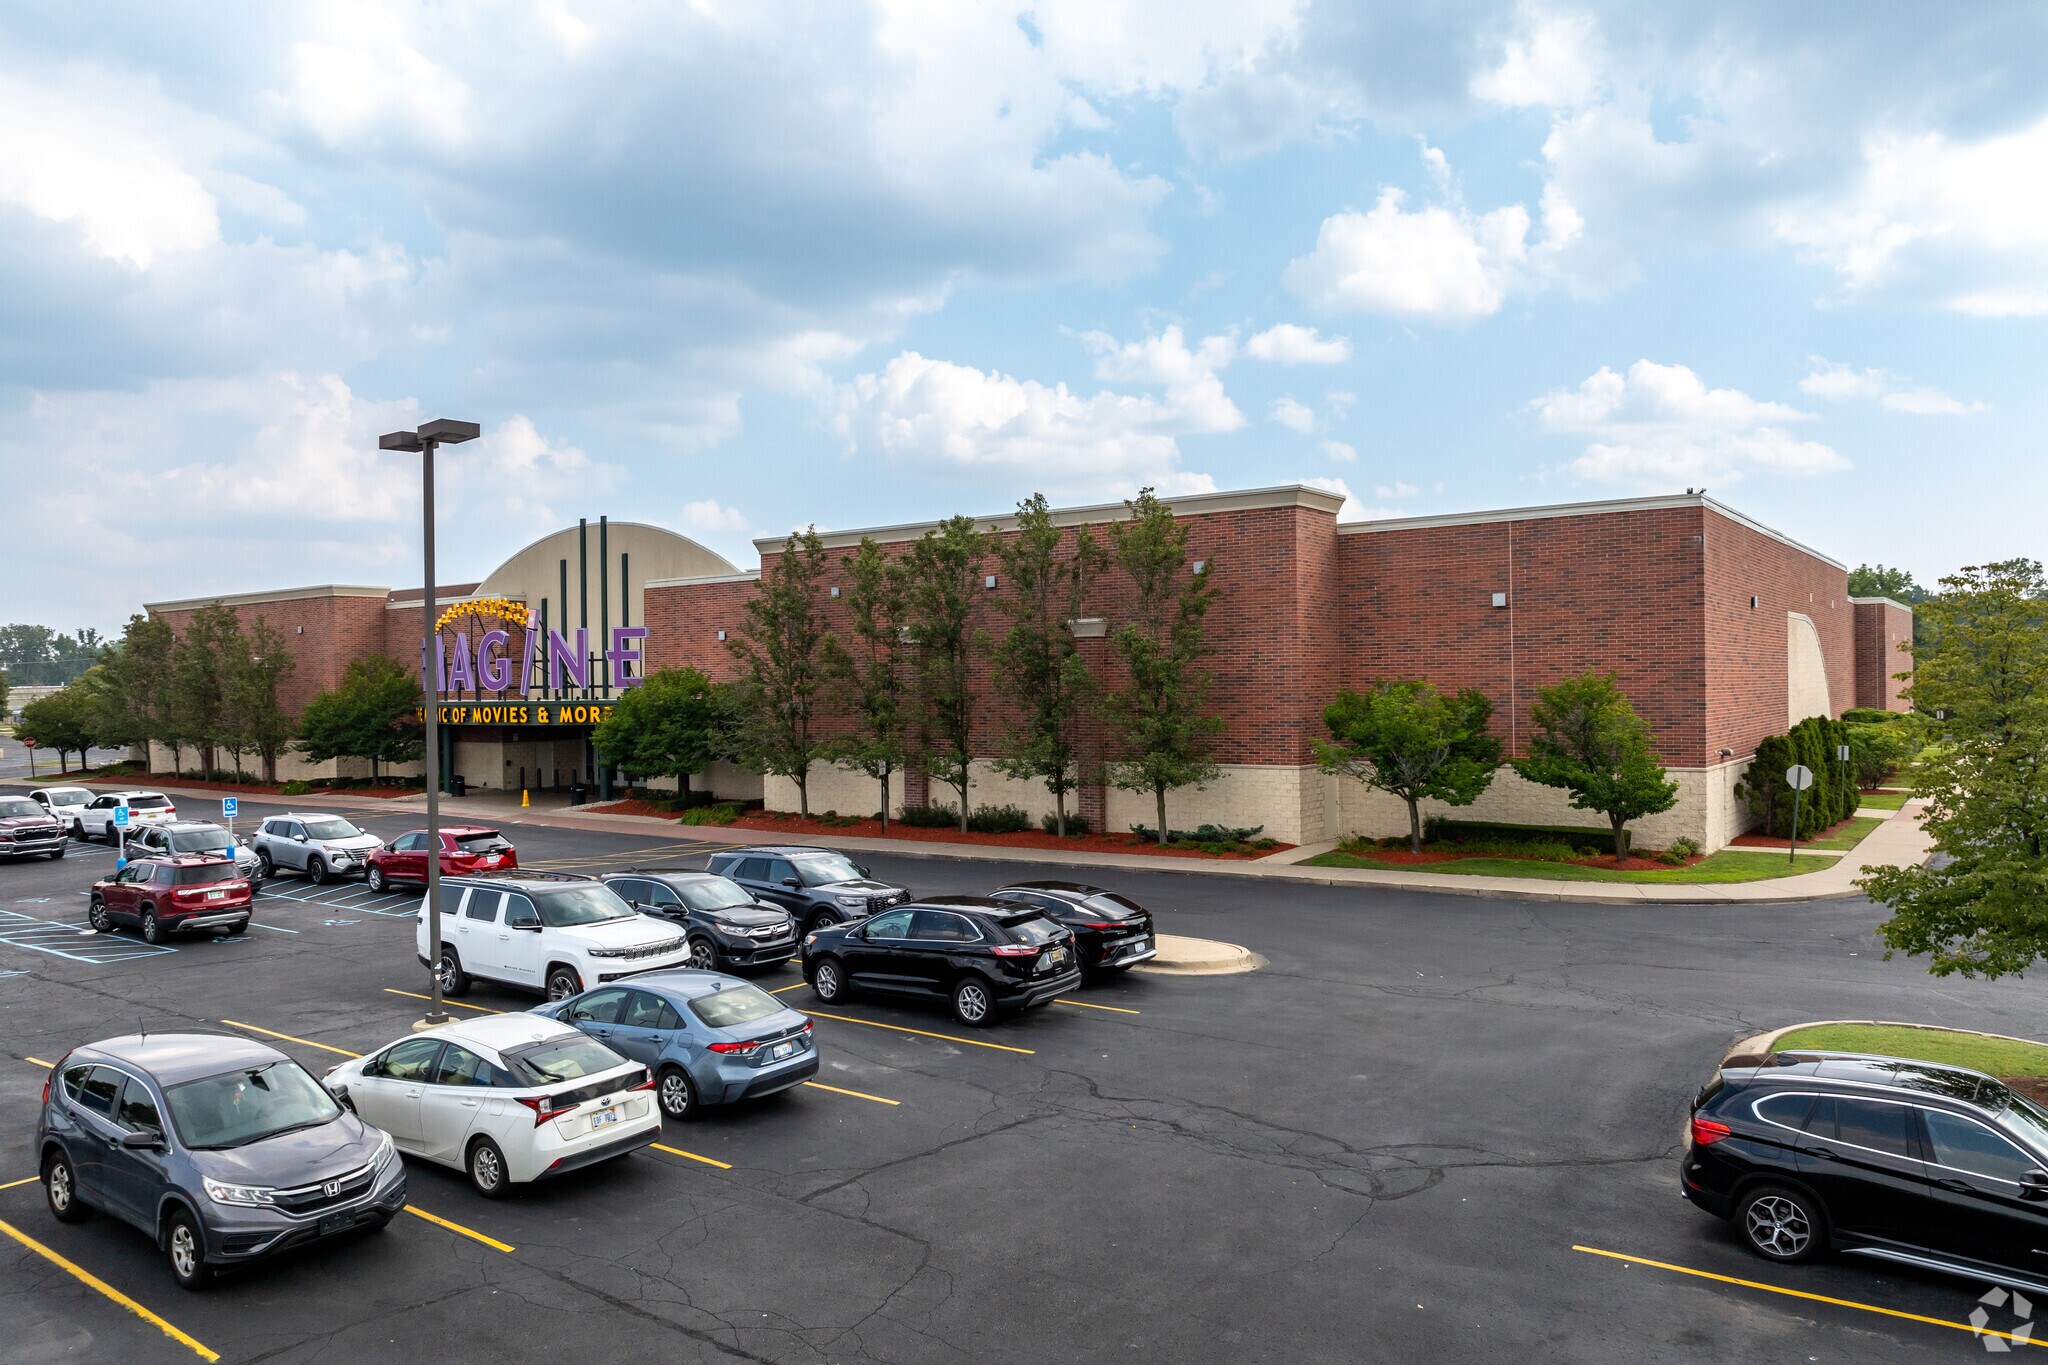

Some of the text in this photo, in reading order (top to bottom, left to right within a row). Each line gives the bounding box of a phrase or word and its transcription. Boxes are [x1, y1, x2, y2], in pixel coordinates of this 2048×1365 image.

[422, 608, 650, 697] AGINE
[452, 707, 467, 723] OF
[472, 706, 528, 723] MOVIES
[537, 706, 549, 723] &
